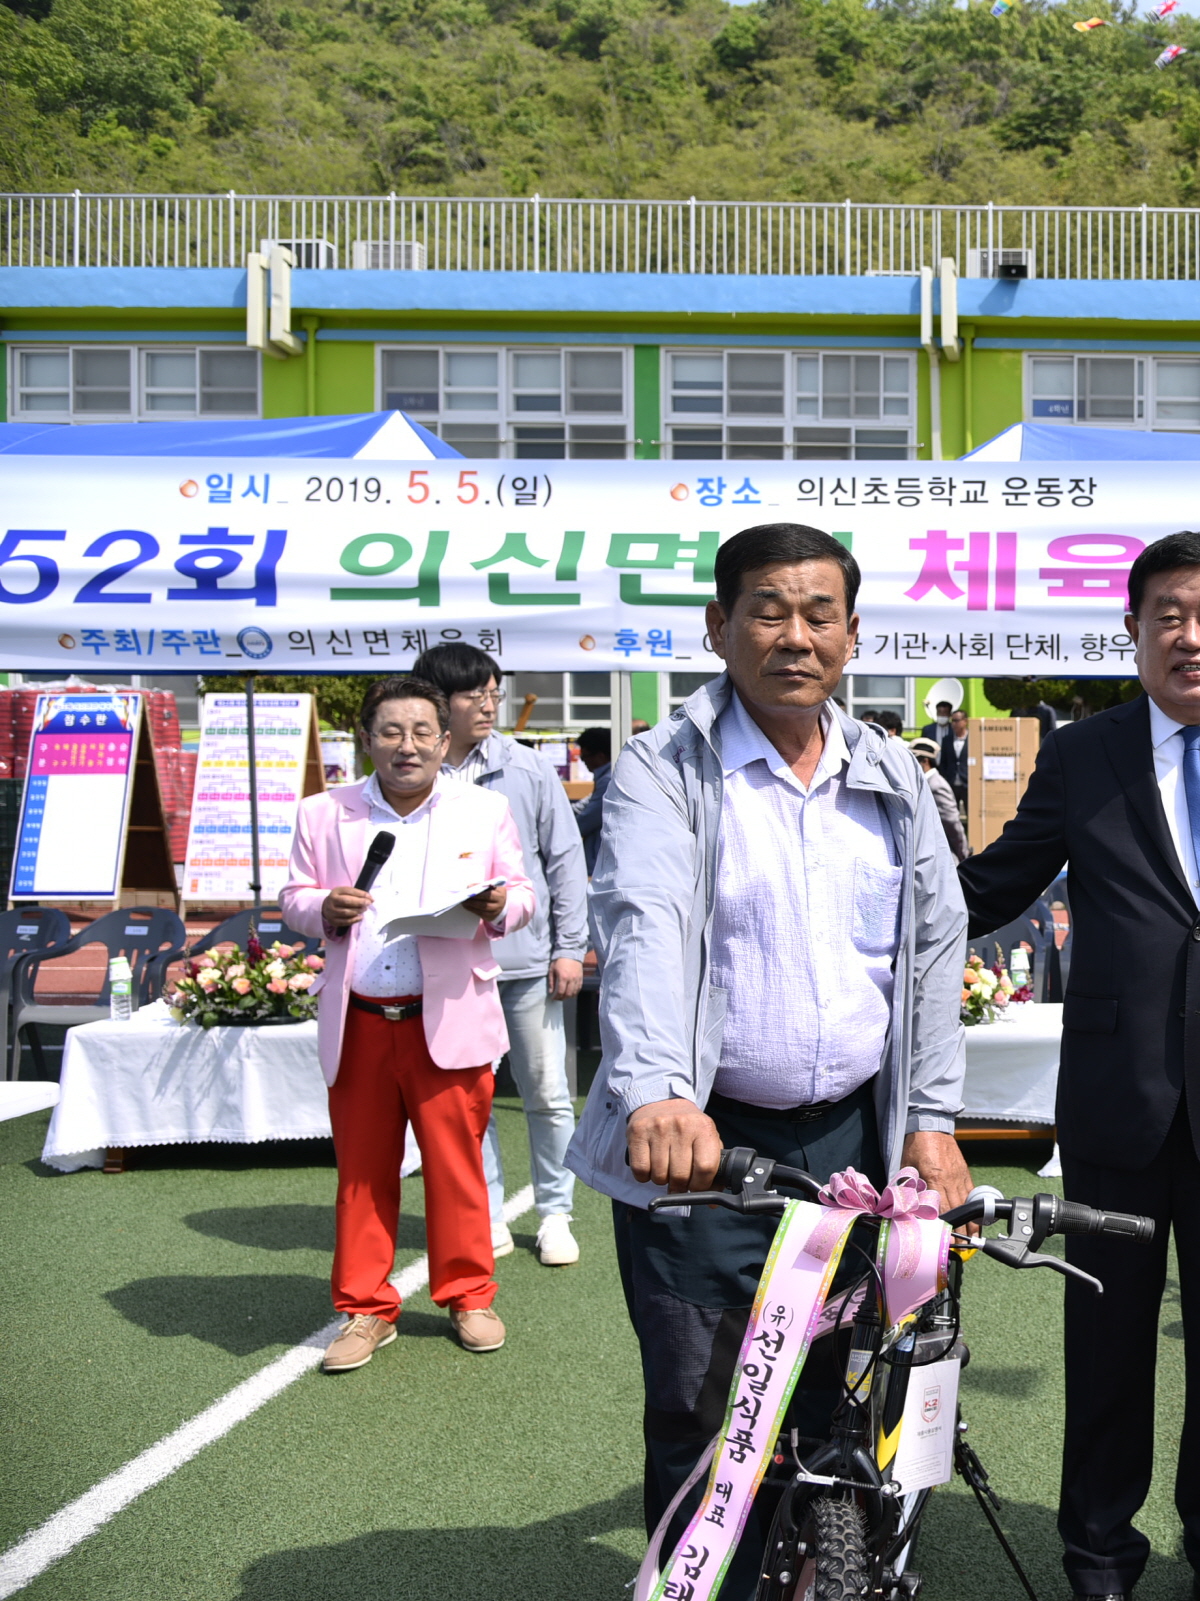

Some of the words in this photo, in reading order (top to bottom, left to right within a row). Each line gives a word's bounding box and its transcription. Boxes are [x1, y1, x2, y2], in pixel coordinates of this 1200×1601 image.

[304, 476, 392, 504] 2019.
[406, 470, 442, 505] 5.
[797, 476, 990, 508] 의신초등학교
[1001, 477, 1098, 508] 운동장
[0, 526, 288, 607] 52회
[331, 530, 854, 609] 의신면
[873, 631, 995, 662] 기관·사회
[1005, 632, 1070, 663] 단체,
[724, 1301, 794, 1464] (유)선일식품
[705, 1480, 733, 1529] 대표
